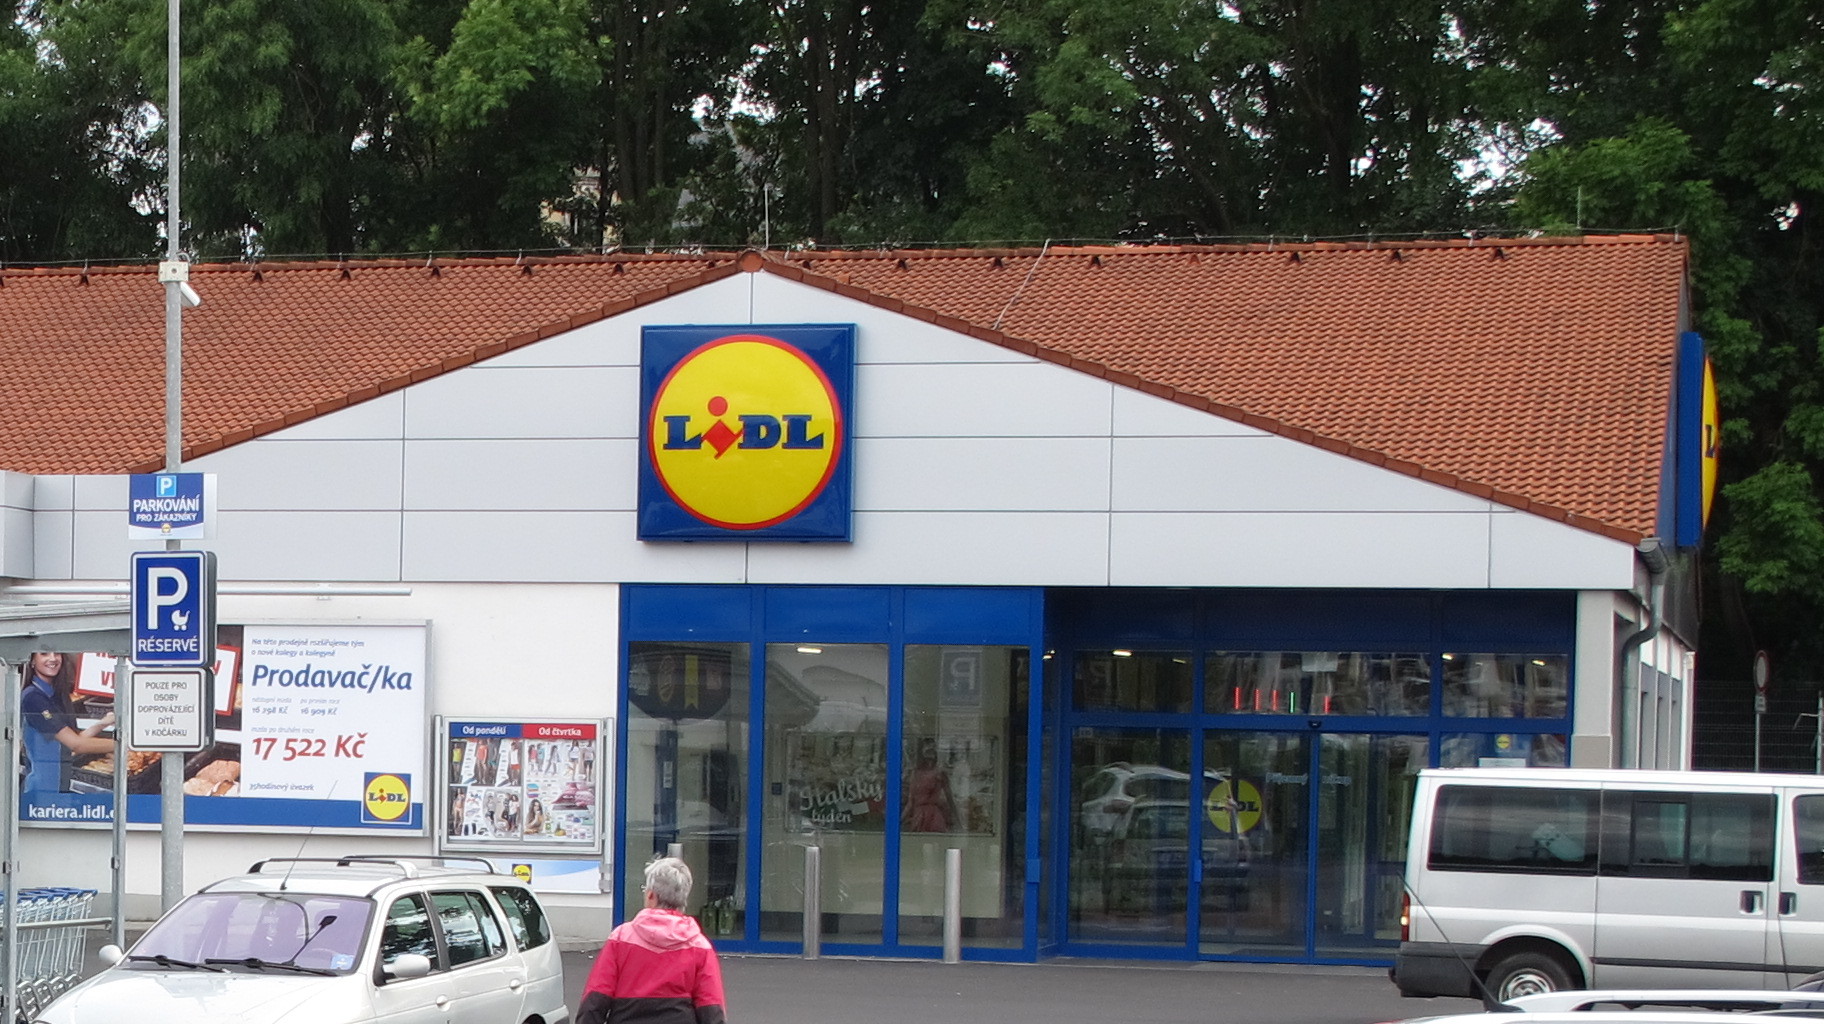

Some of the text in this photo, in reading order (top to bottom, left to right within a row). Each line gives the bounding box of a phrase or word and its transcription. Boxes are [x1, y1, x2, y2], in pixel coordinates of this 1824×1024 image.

[662, 396, 824, 458] LIDL
[160, 477, 173, 495] P
[133, 494, 200, 512] PARKOVÁNÍ
[136, 512, 197, 522] PRO ZÁKAZNÍKY
[147, 566, 188, 630] P
[138, 635, 198, 652] RÉSERVÉ
[145, 682, 187, 690] POUZE PRO
[251, 663, 413, 694] Prodavač/ka
[138, 704, 195, 713] DOPROVÁZEJÍCÍ
[462, 726, 507, 737] Od pondělí
[538, 727, 582, 737] Od čtvrtka
[252, 732, 369, 761] 17 522 Kč
[29, 803, 114, 819] kariera.lidl.c
[812, 806, 852, 824] týden
